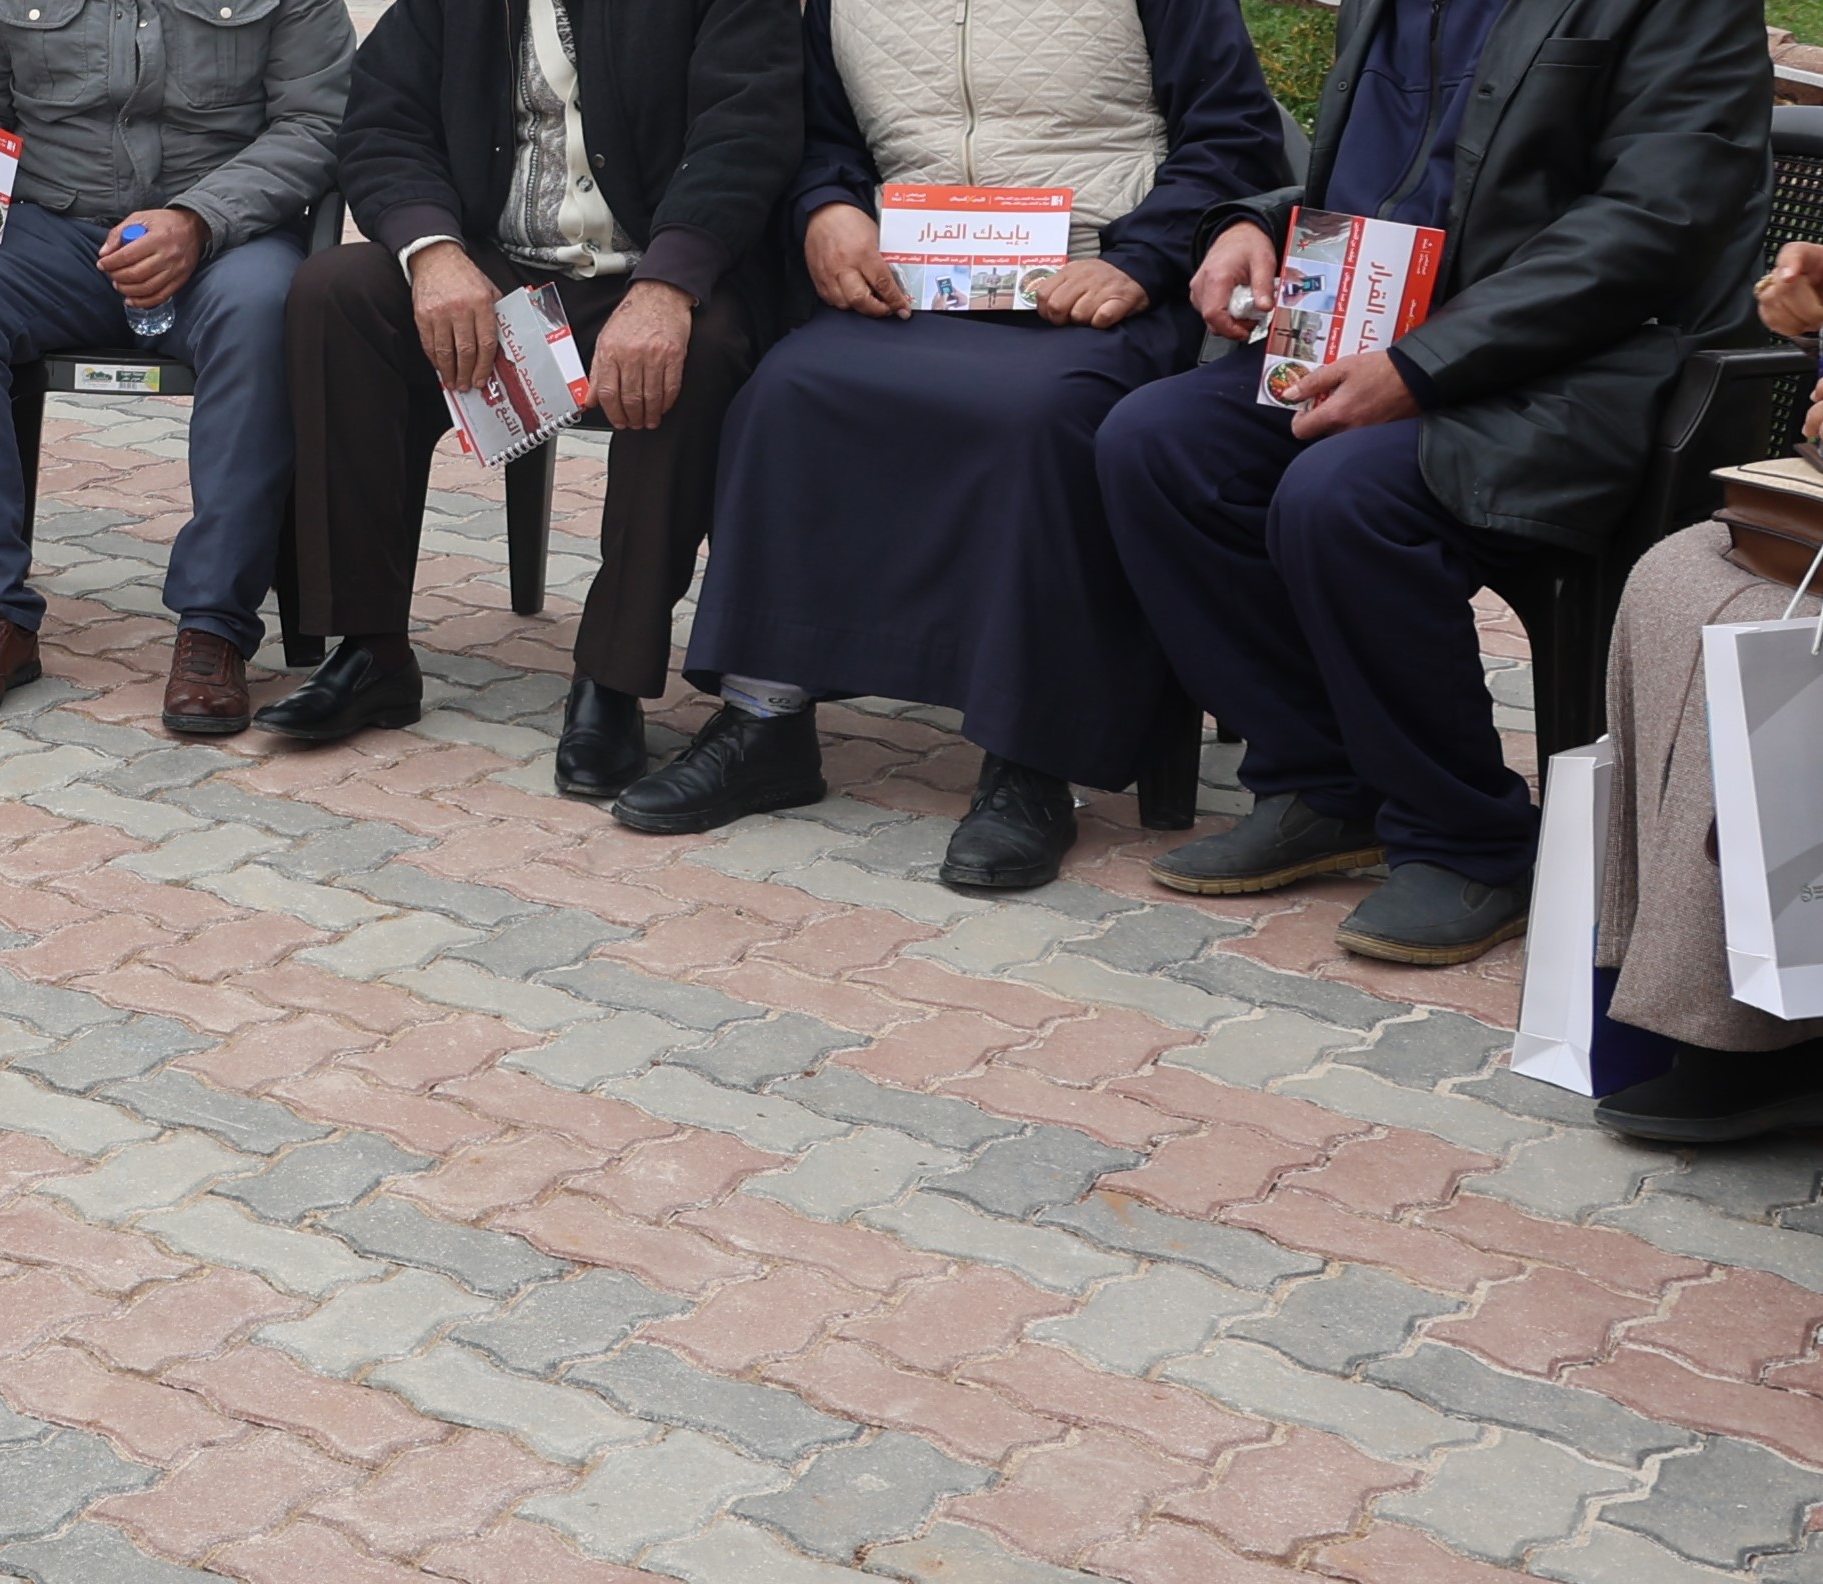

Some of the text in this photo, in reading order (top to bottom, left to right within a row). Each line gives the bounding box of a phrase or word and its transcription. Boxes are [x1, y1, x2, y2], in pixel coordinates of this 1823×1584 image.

[918, 222, 1030, 246] بإيدك القرار
[1368, 261, 1393, 315] القرار
